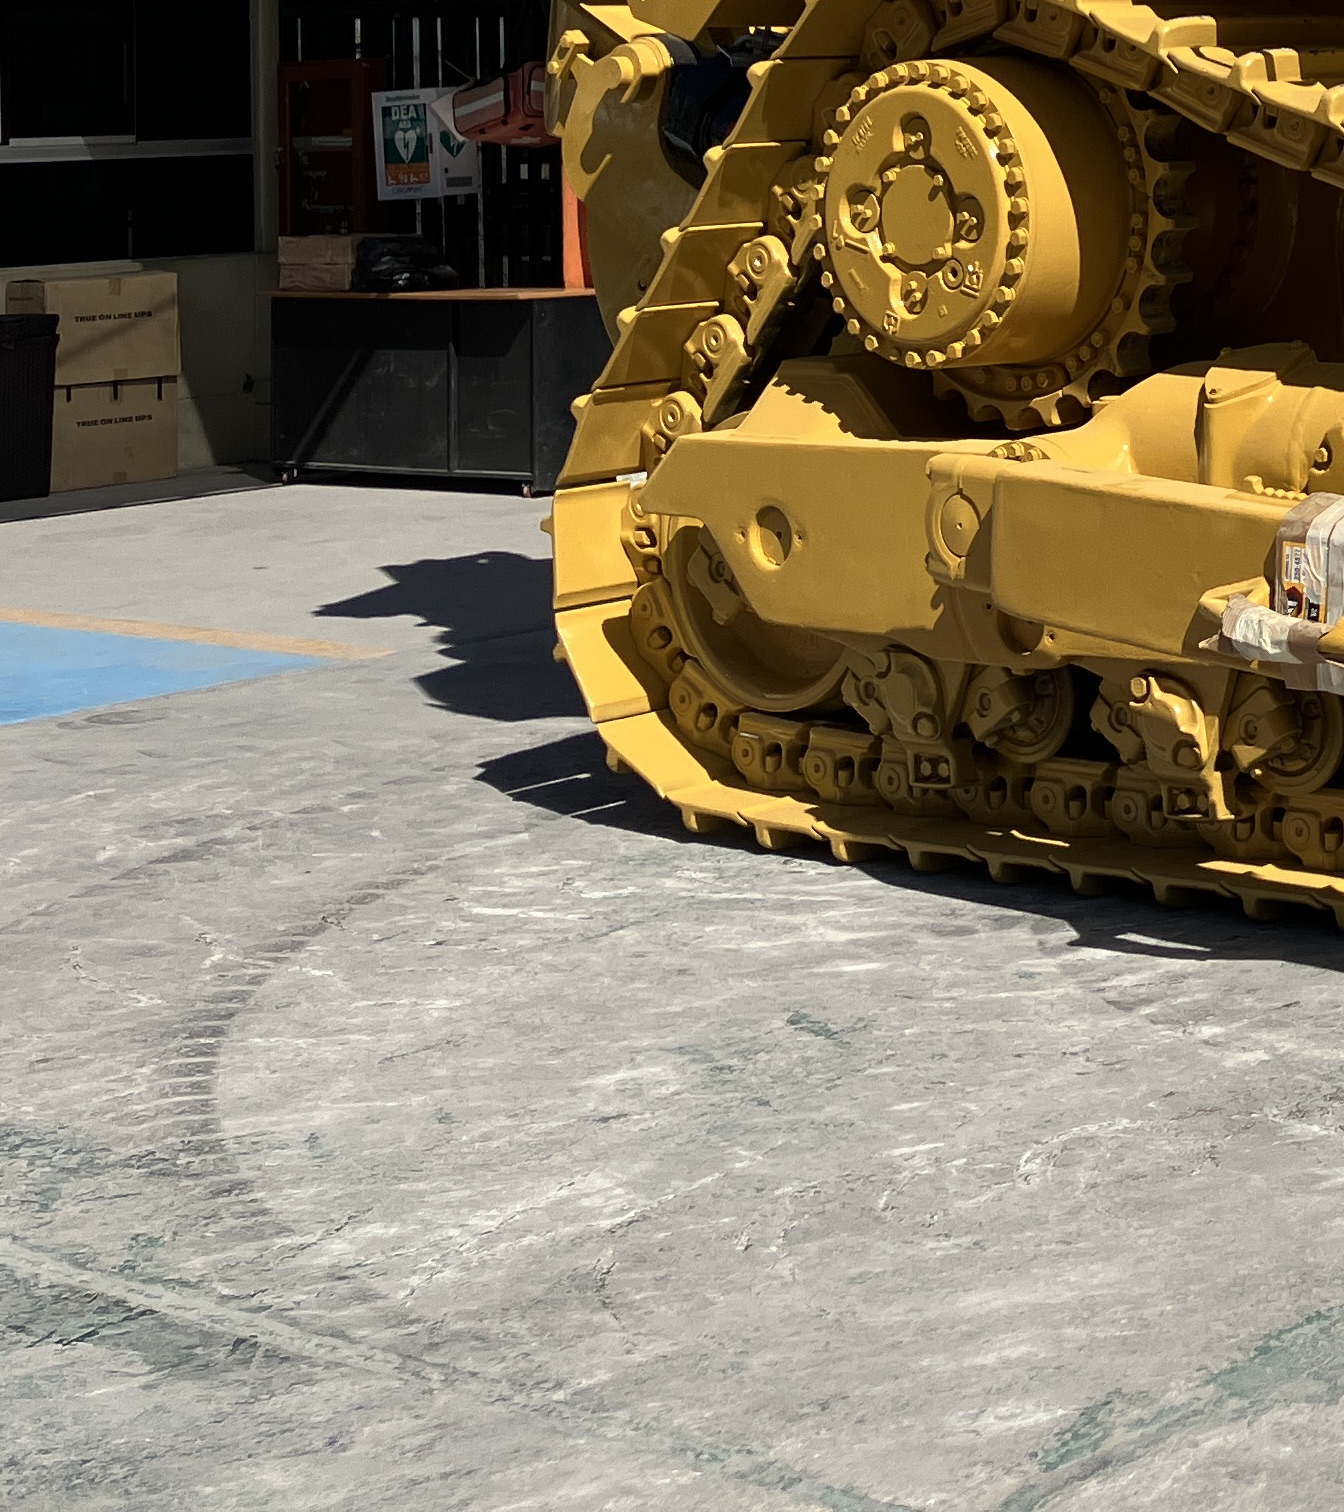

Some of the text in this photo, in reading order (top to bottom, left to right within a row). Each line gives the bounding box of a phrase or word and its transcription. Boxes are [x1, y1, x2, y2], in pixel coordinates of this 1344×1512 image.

[391, 104, 417, 121] DEA
[74, 315, 97, 323] TRUE
[113, 312, 132, 320] LINE
[76, 419, 98, 428] TRUE
[114, 416, 133, 424] LINE
[135, 414, 153, 422] UPS
